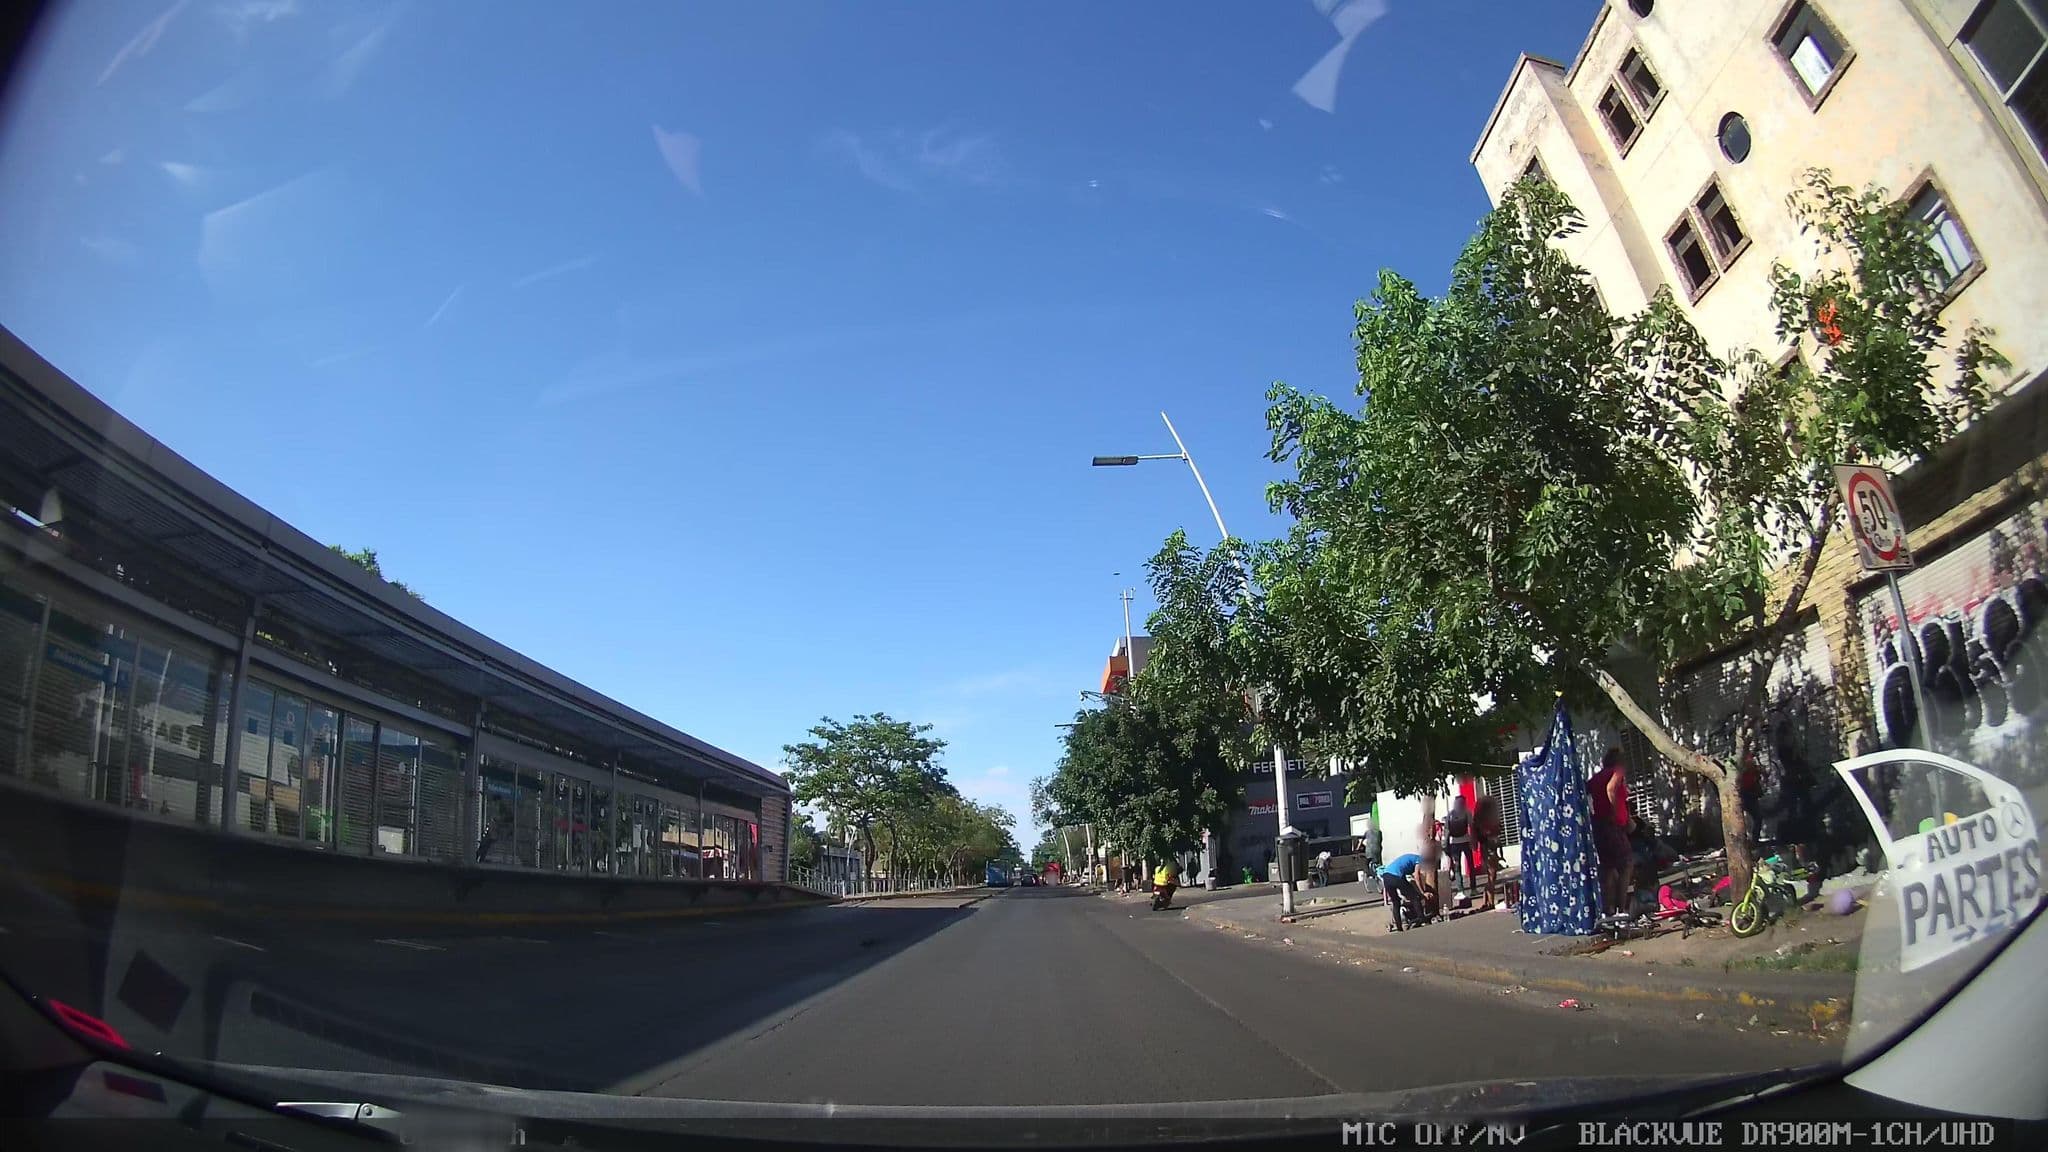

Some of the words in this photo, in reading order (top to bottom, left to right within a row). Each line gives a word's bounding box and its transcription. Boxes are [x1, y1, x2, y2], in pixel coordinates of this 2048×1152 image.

[1857, 489, 1888, 532] 50
[1927, 812, 1998, 863] AUTO
[1902, 838, 2041, 946] PARTES
